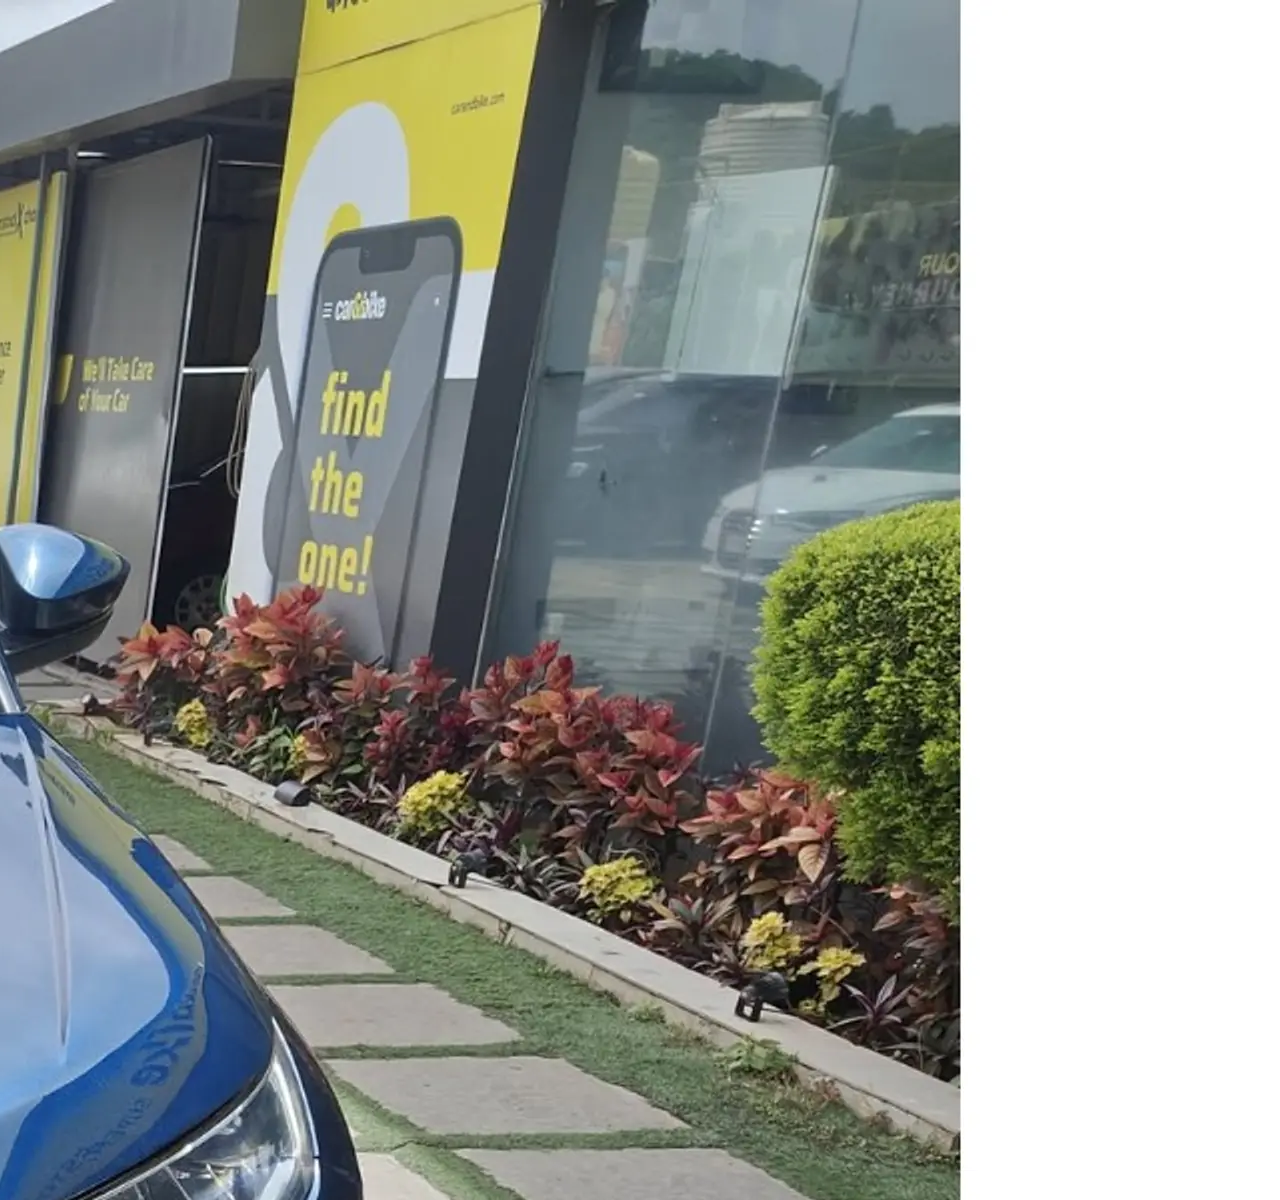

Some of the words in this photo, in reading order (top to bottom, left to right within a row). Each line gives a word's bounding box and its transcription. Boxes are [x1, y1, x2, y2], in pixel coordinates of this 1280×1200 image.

[78, 386, 91, 412] of
[91, 388, 112, 412] Your
[112, 387, 130, 412] Car
[107, 356, 129, 381] Take
[130, 356, 155, 381] Care
[320, 366, 391, 438] find
[308, 451, 363, 518] the
[297, 535, 373, 596] one!
